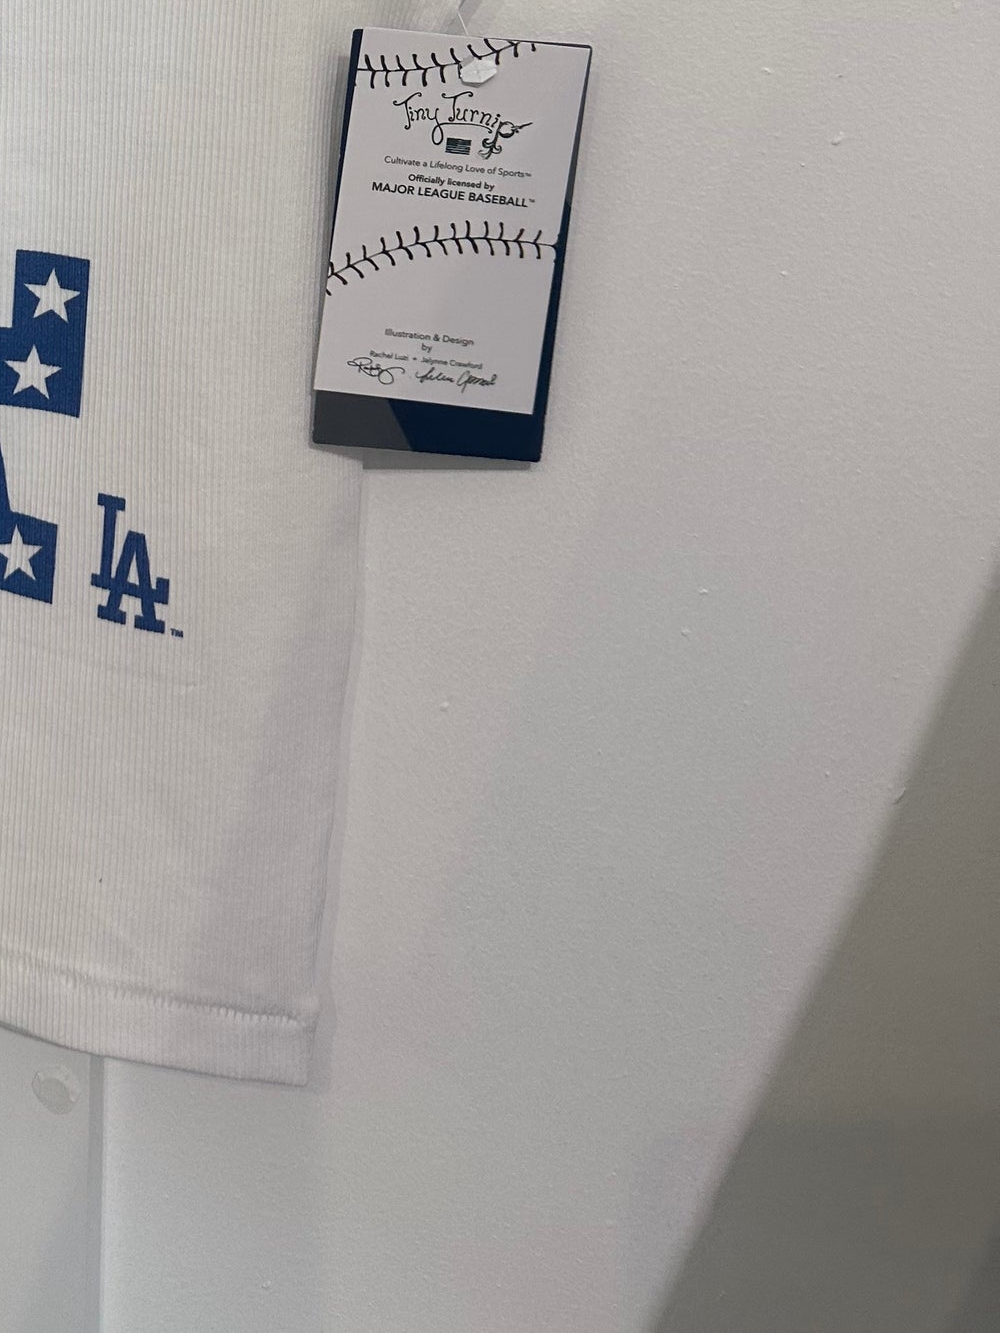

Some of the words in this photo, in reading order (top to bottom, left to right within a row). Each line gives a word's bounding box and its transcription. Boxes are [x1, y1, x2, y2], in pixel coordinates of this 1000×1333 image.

[393, 92, 443, 146] Tiny
[442, 91, 533, 160] Turnip
[384, 156, 421, 168] Cultivate
[430, 160, 463, 173] Lifelong
[465, 164, 485, 175] Love
[487, 166, 497, 175] of
[372, 181, 414, 195] MAJOR
[418, 186, 465, 201] LEAGUE
[408, 173, 445, 186] Officially
[447, 177, 482, 189] licensed
[484, 181, 495, 191] by
[385, 328, 431, 341] Illustration
[442, 334, 474, 347] Design
[421, 343, 433, 353] by
[370, 350, 394, 359] Rachel
[450, 359, 483, 370] Crawford
[90, 492, 169, 634] LA
